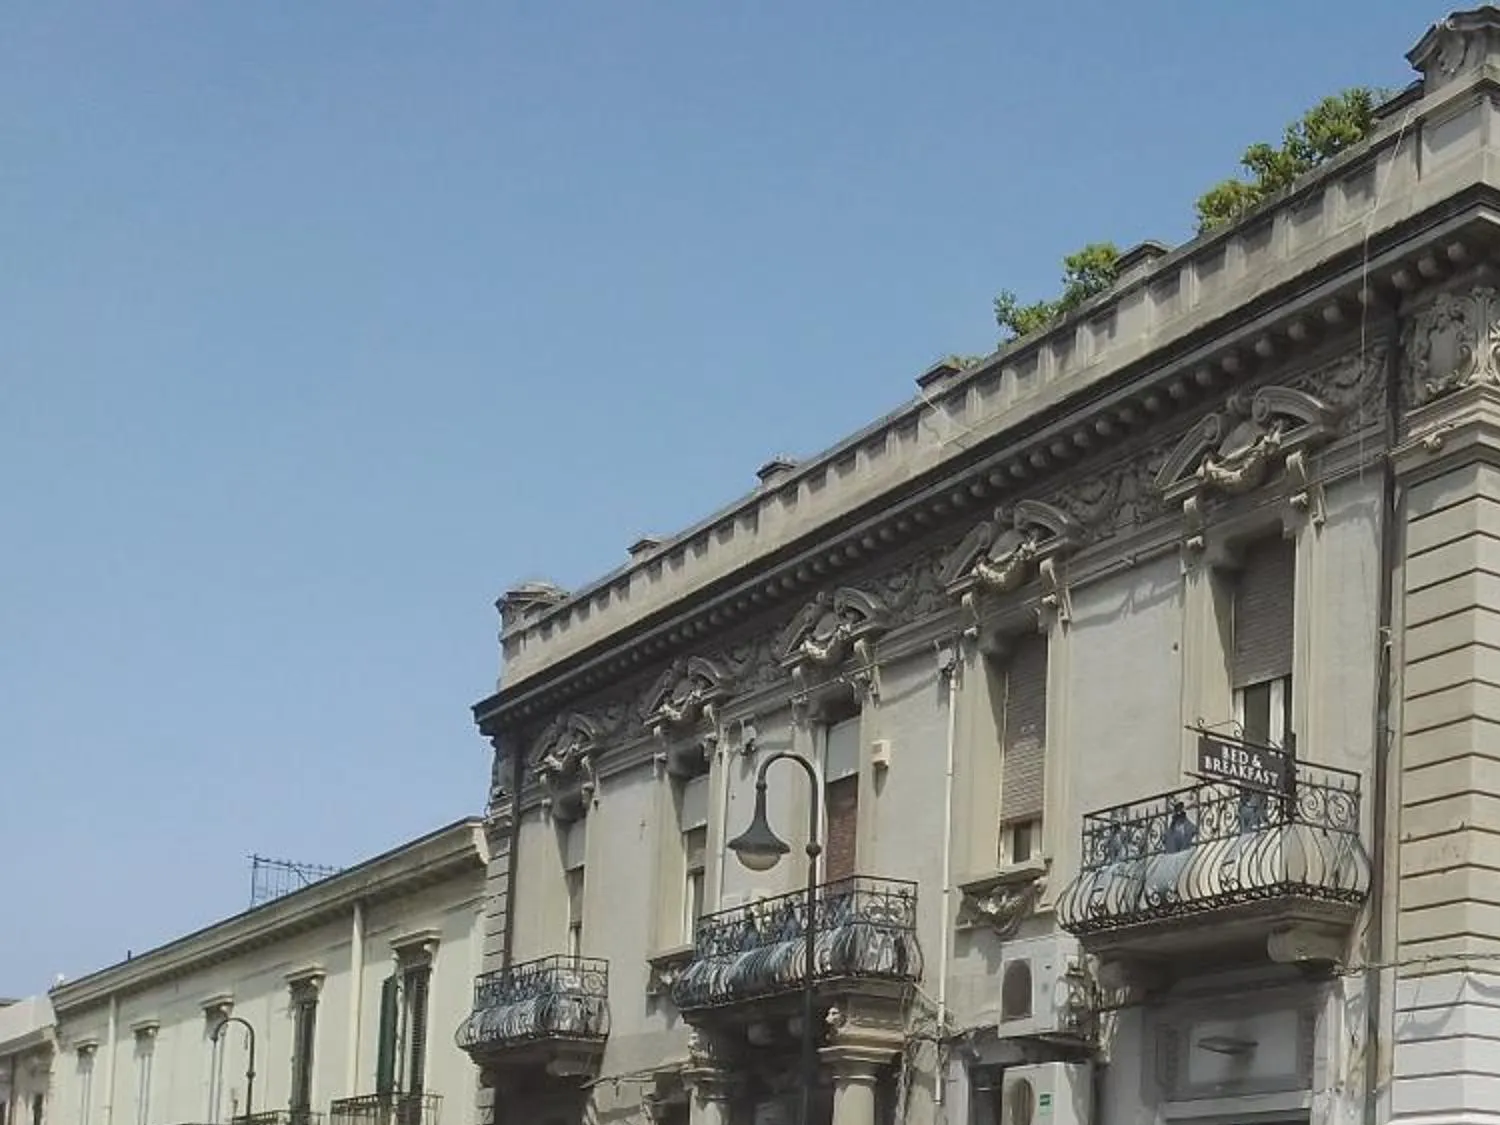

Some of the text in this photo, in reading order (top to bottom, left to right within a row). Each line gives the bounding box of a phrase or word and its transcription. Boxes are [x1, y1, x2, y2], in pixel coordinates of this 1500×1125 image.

[1204, 755, 1280, 786] BREAKFAST
[1221, 745, 1263, 769] BED &
